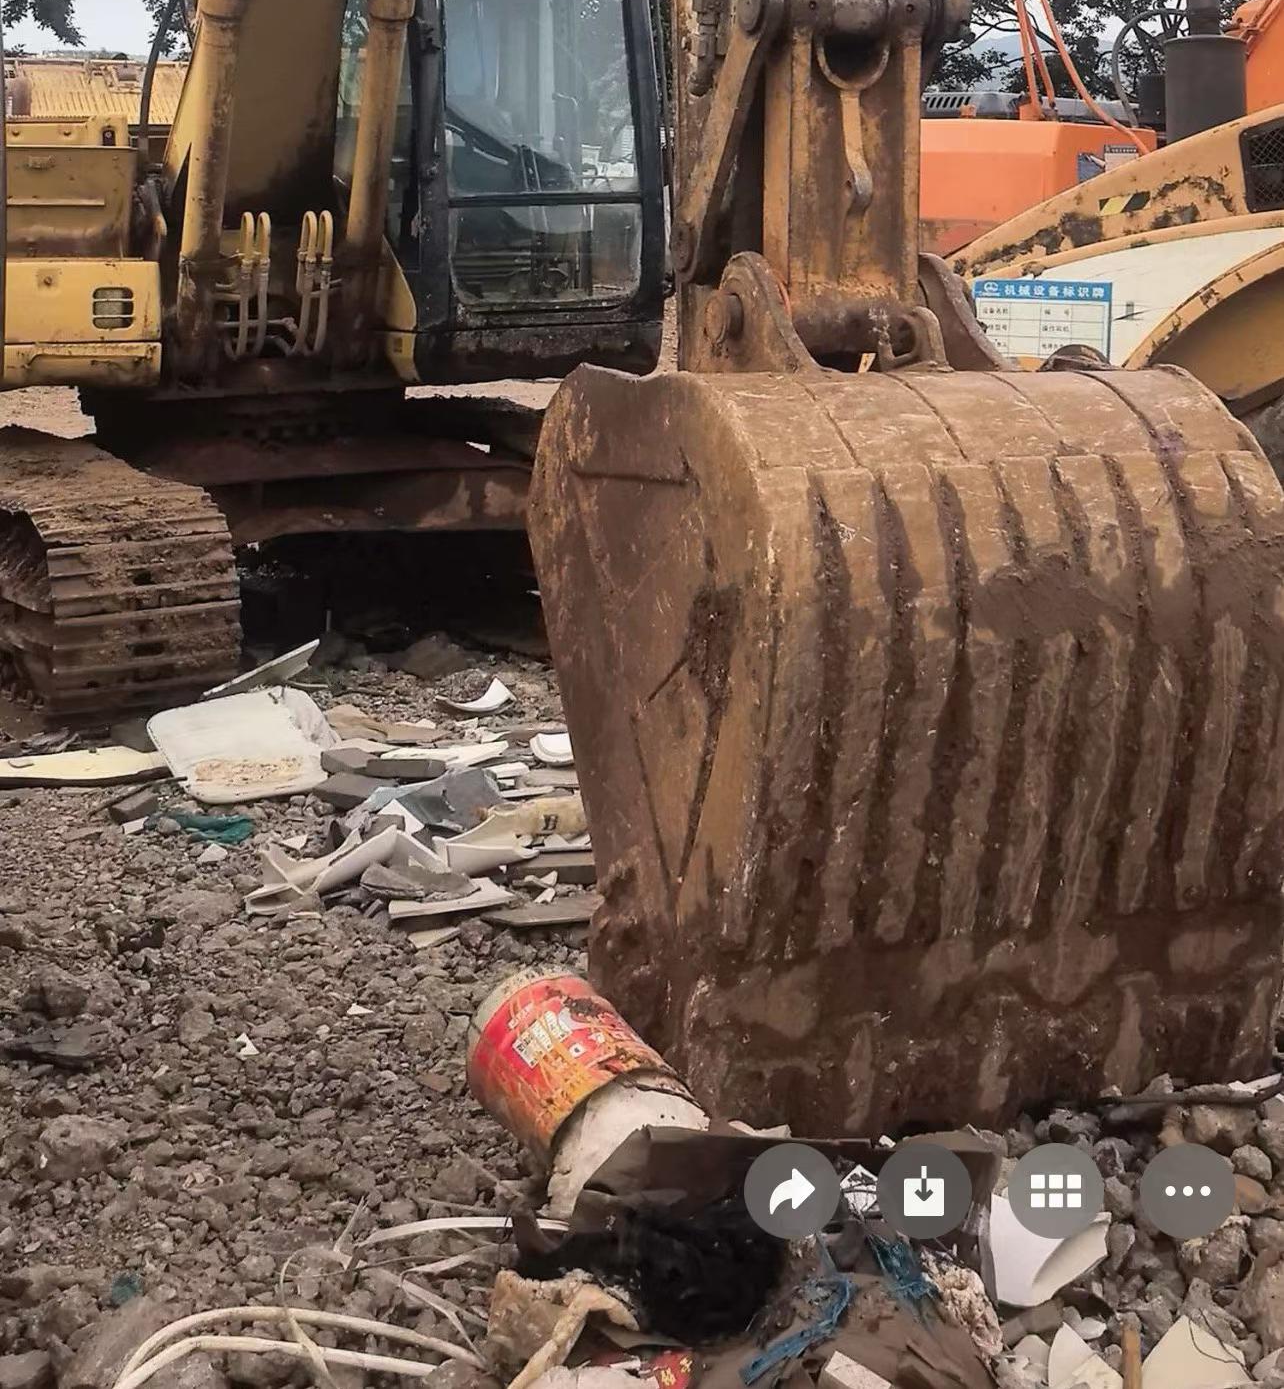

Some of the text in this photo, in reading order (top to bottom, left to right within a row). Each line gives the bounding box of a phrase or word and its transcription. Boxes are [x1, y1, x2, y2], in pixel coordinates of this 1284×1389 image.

[1004, 284, 1105, 298] 机械设备标识牌
